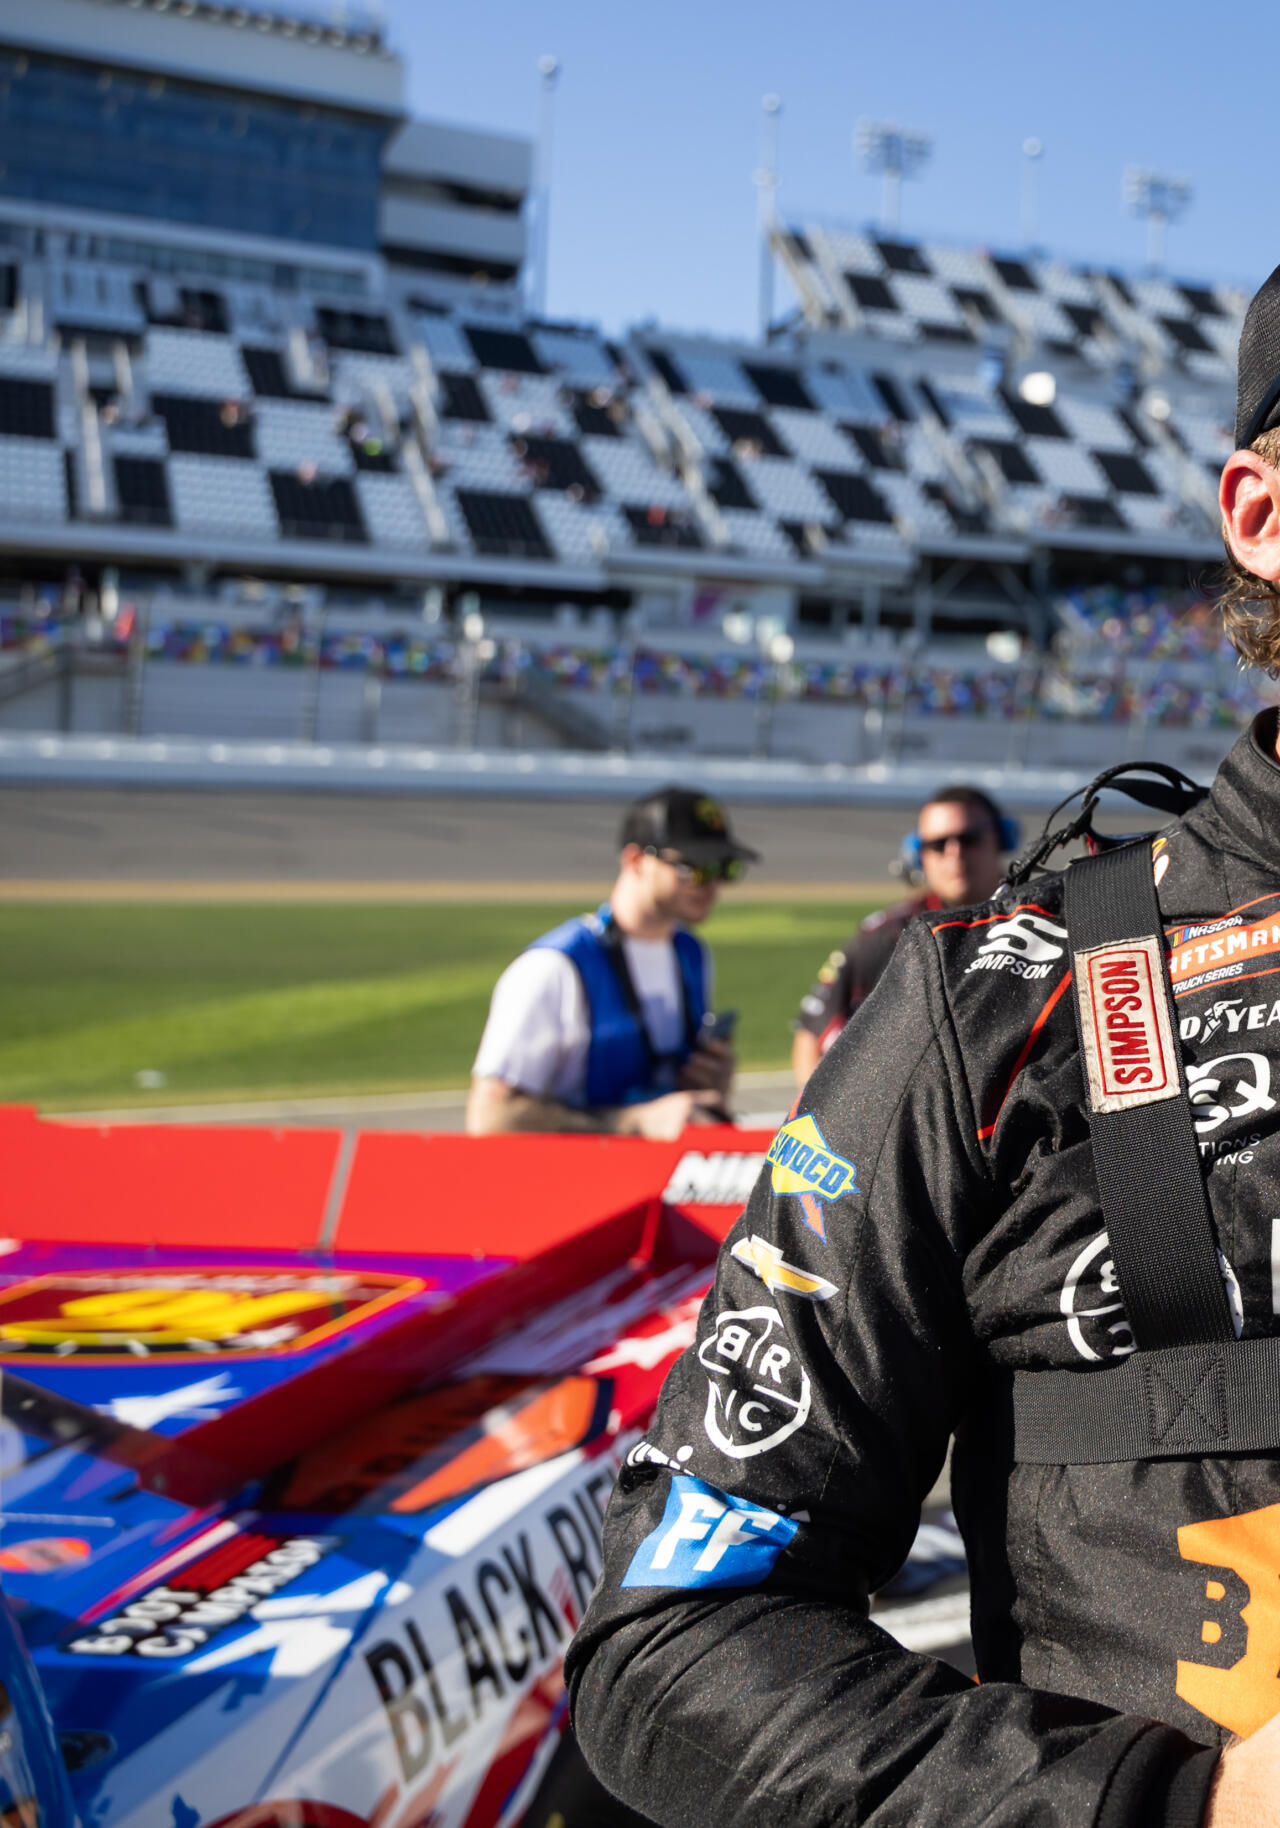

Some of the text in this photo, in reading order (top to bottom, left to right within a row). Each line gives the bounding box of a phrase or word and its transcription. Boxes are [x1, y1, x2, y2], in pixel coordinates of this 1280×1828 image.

[1188, 916, 1244, 939] NASCAR
[965, 953, 1054, 979] SIMPSON
[1204, 963, 1244, 983] SERIES
[1100, 960, 1154, 1085] SIMPSON
[1199, 1133, 1262, 1157] TIONS
[650, 1492, 780, 1563] FF
[365, 1532, 564, 1786] BLACK
